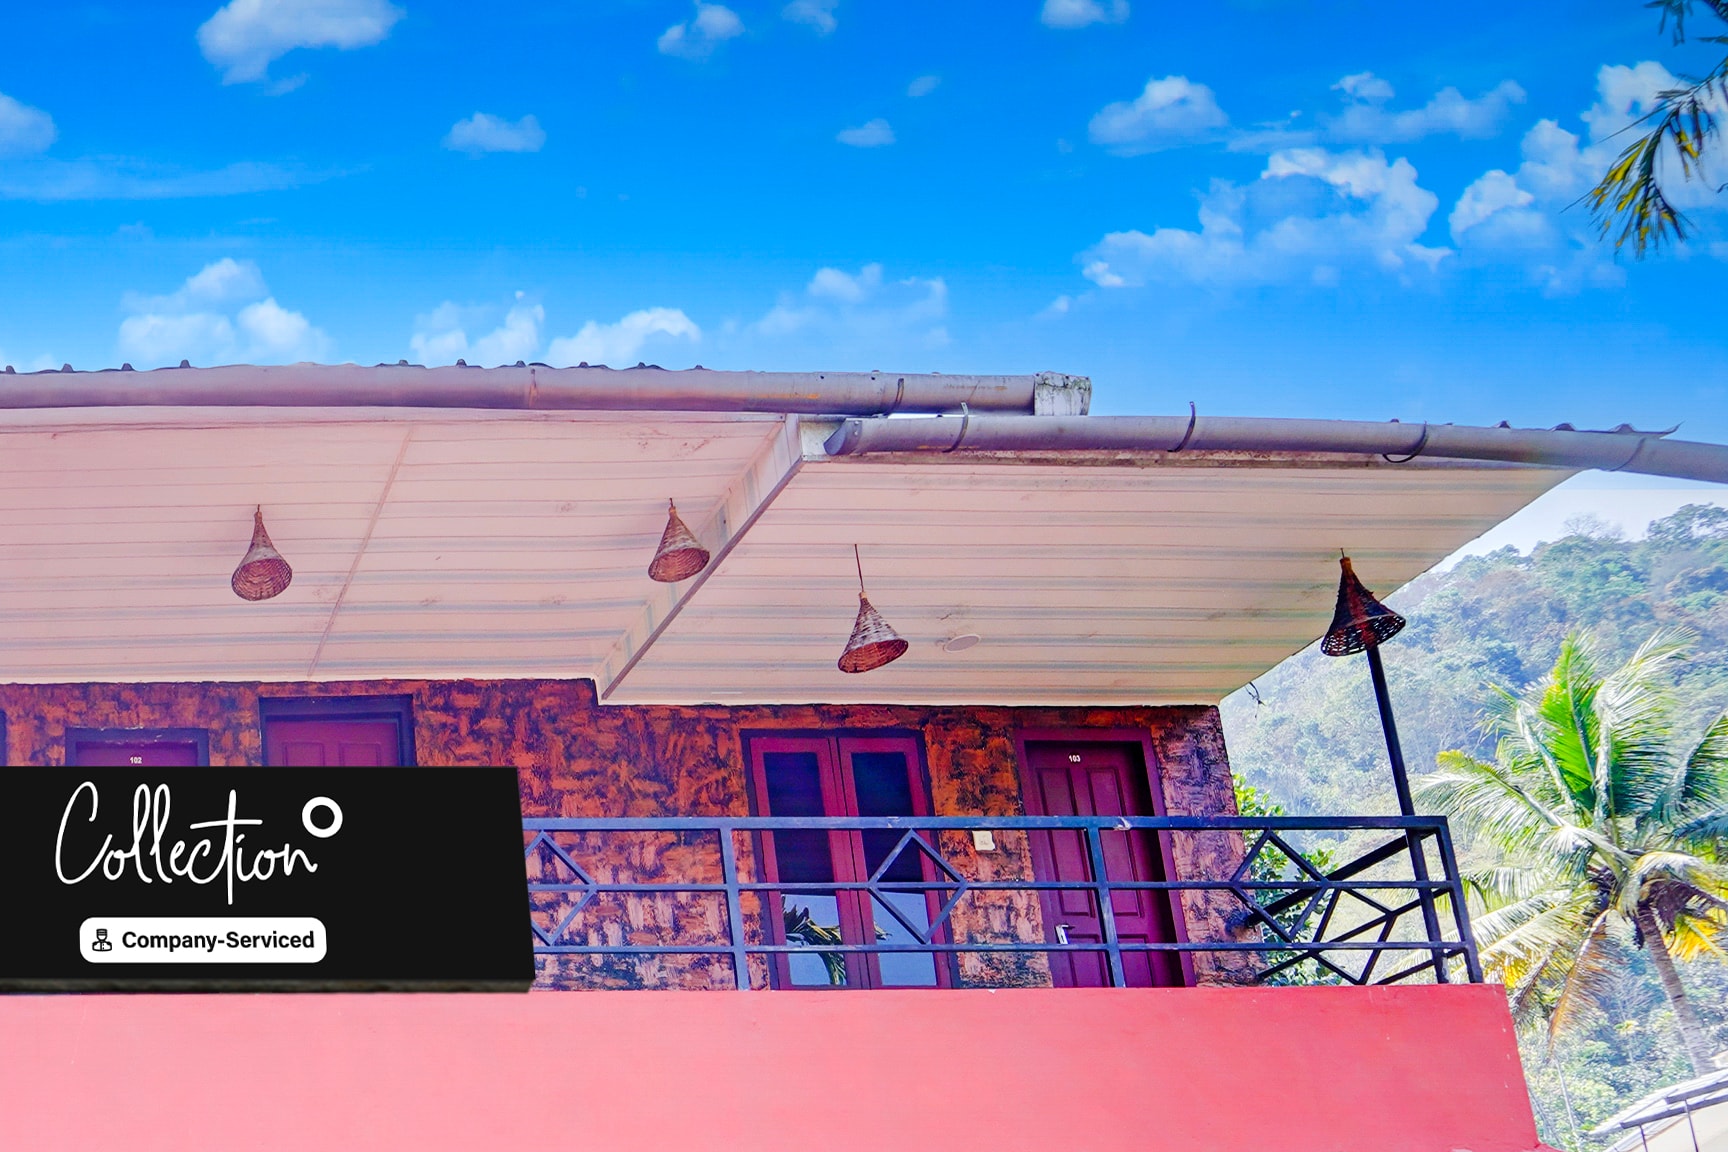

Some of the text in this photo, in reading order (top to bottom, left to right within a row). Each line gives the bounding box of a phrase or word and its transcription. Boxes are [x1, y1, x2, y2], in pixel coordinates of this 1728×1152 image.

[129, 756, 143, 764] 102
[1068, 754, 1081, 763] 103
[55, 781, 318, 906] Collection
[122, 930, 315, 953] Company-Serviced
